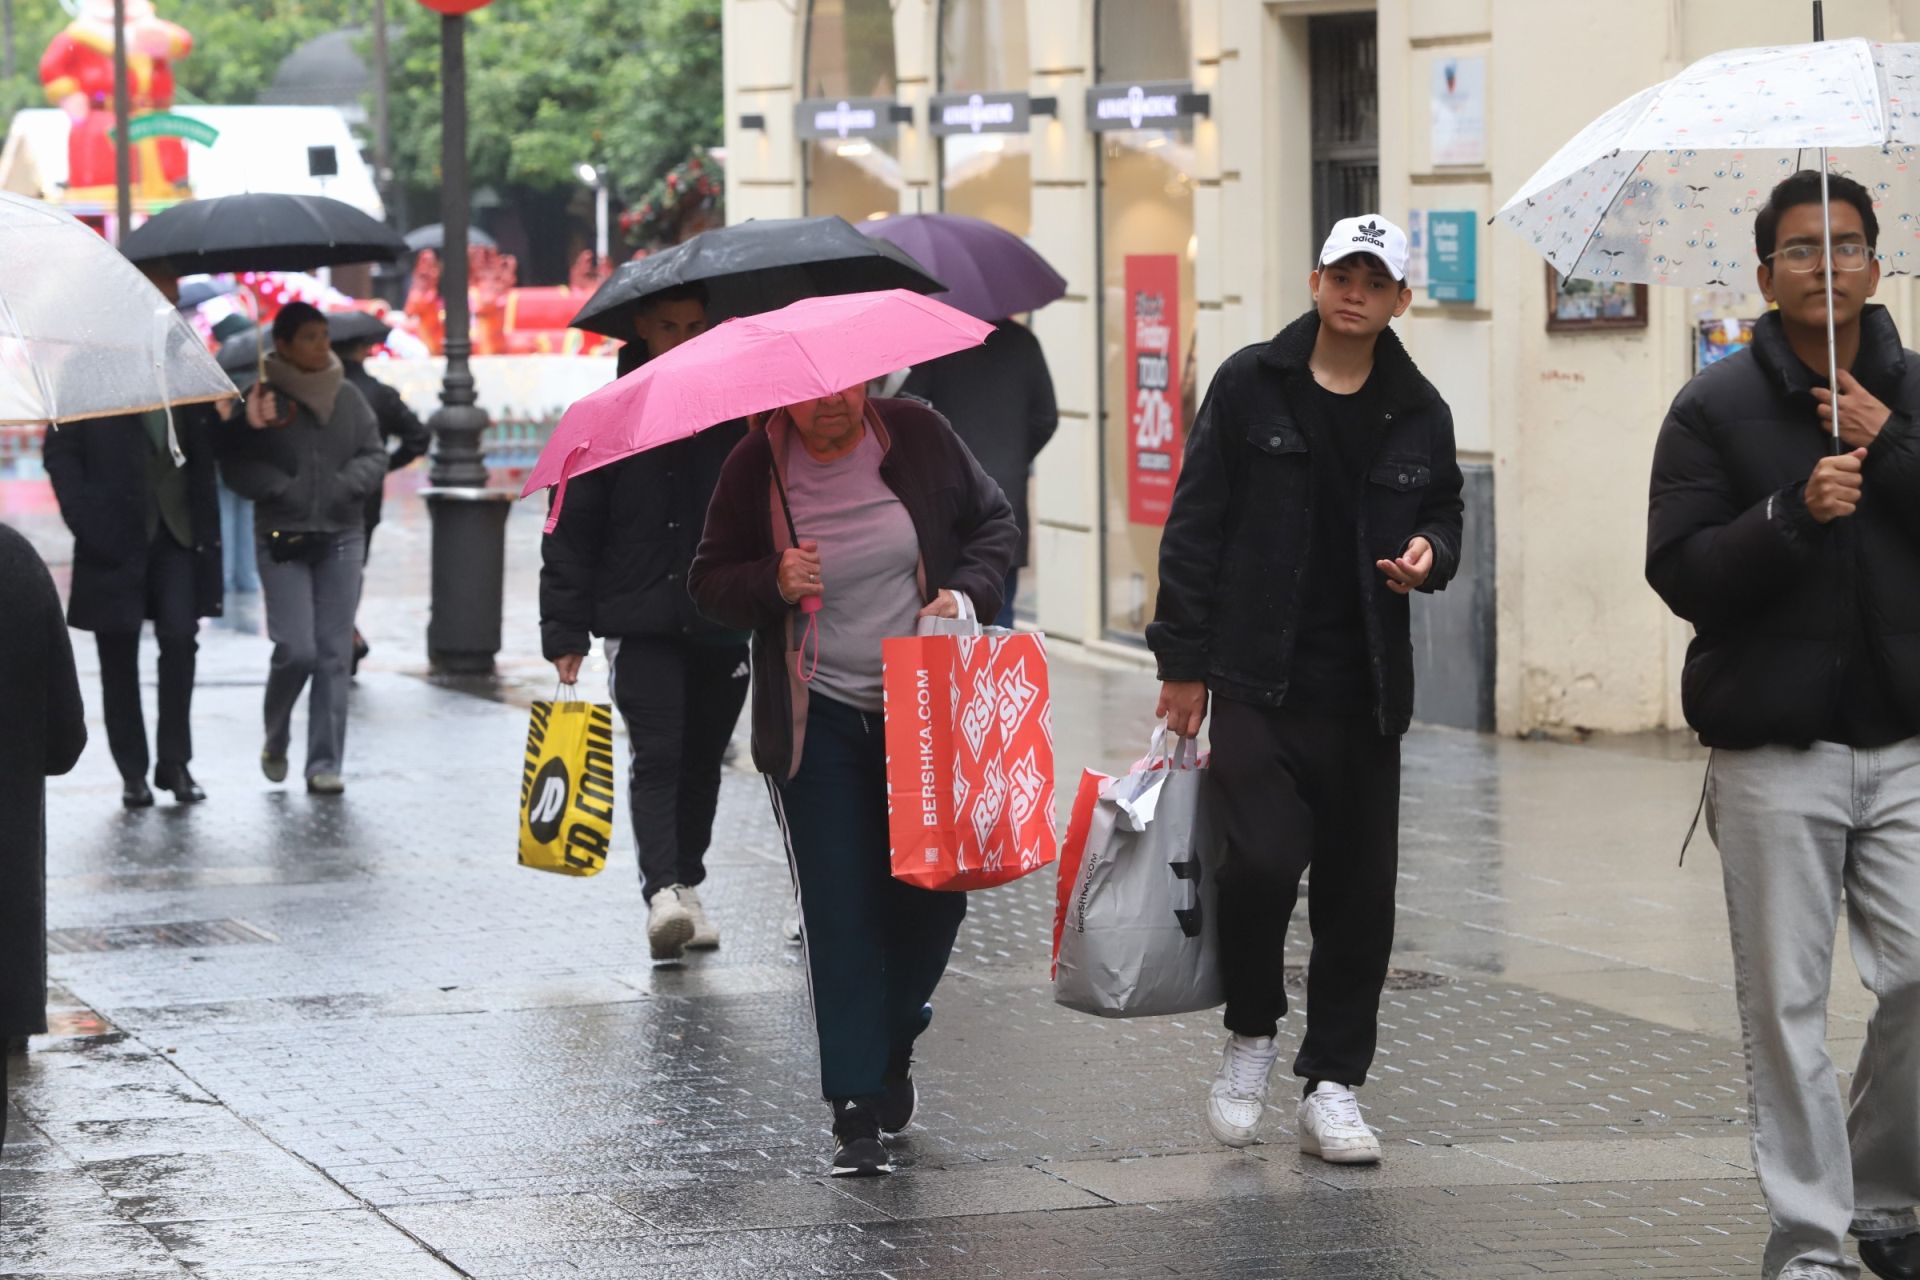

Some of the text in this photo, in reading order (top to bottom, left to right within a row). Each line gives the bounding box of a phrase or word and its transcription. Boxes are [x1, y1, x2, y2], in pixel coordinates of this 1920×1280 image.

[1352, 235, 1385, 249] adidas
[916, 669, 938, 827] BERSHKA.COM
[530, 776, 566, 823] JD
